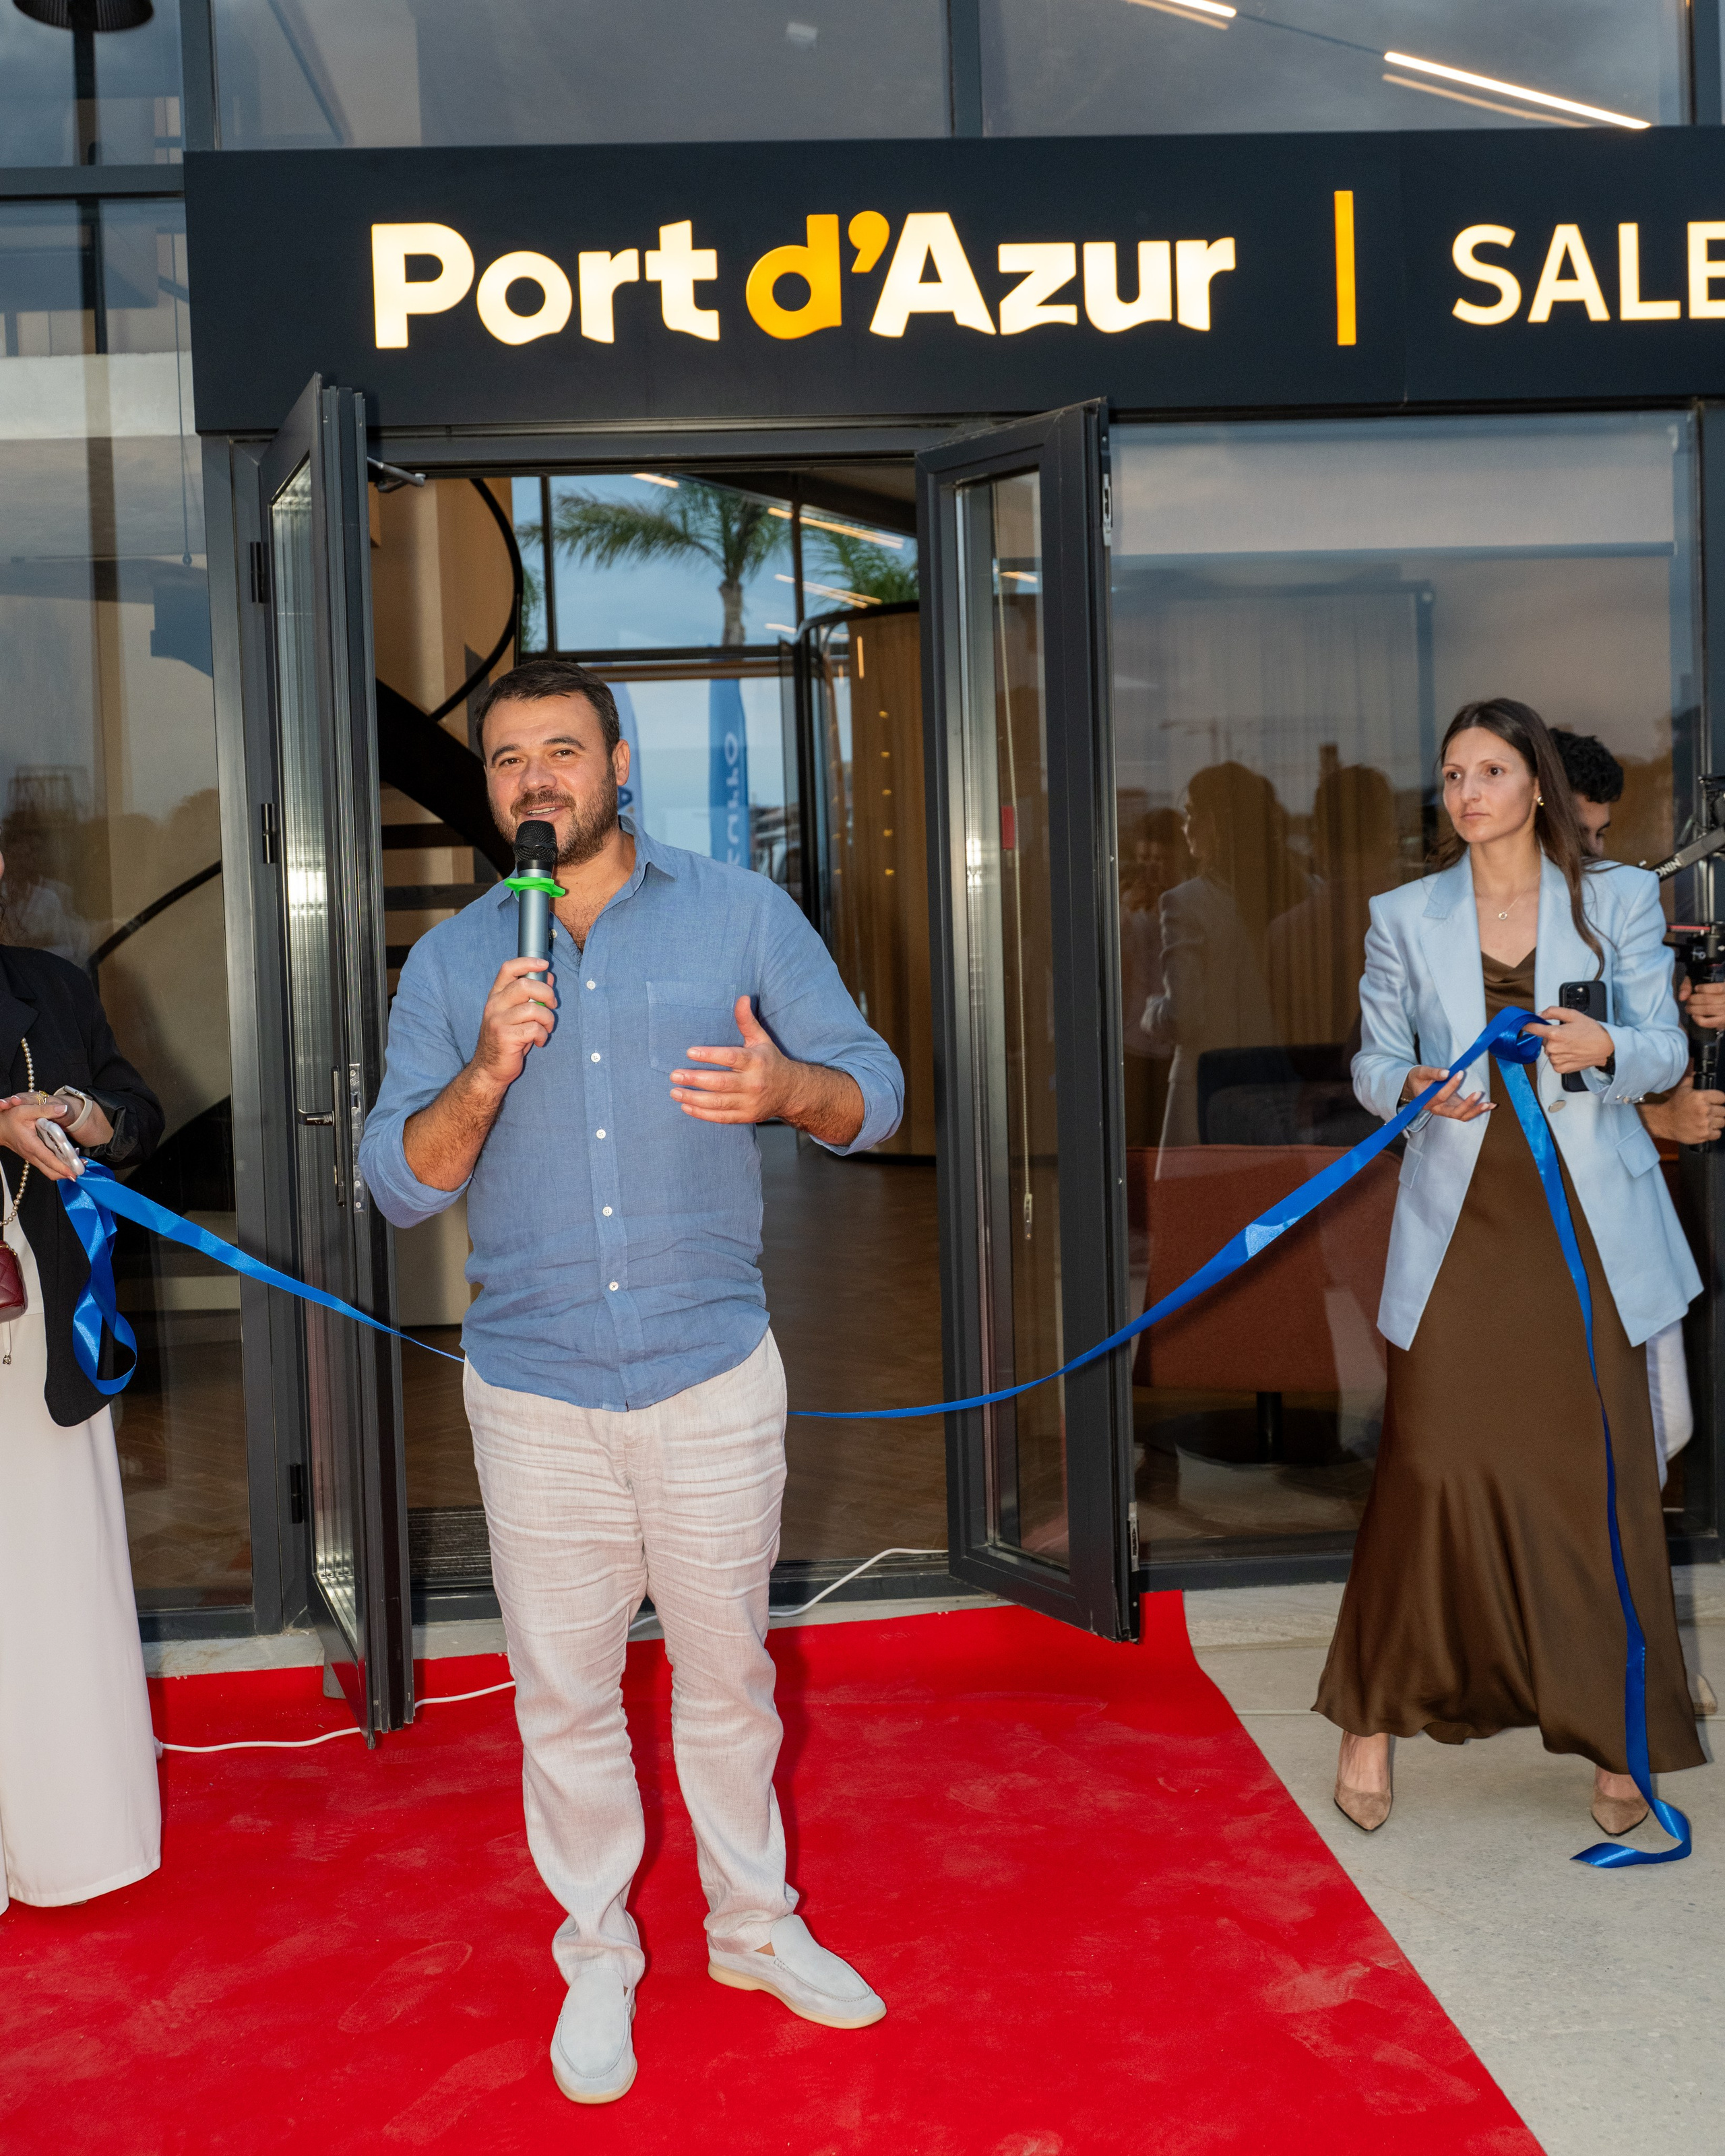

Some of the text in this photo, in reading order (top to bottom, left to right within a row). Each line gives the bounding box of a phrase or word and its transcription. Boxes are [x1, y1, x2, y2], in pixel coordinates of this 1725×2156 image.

[371, 211, 1725, 349] Port d'Azur SALE
